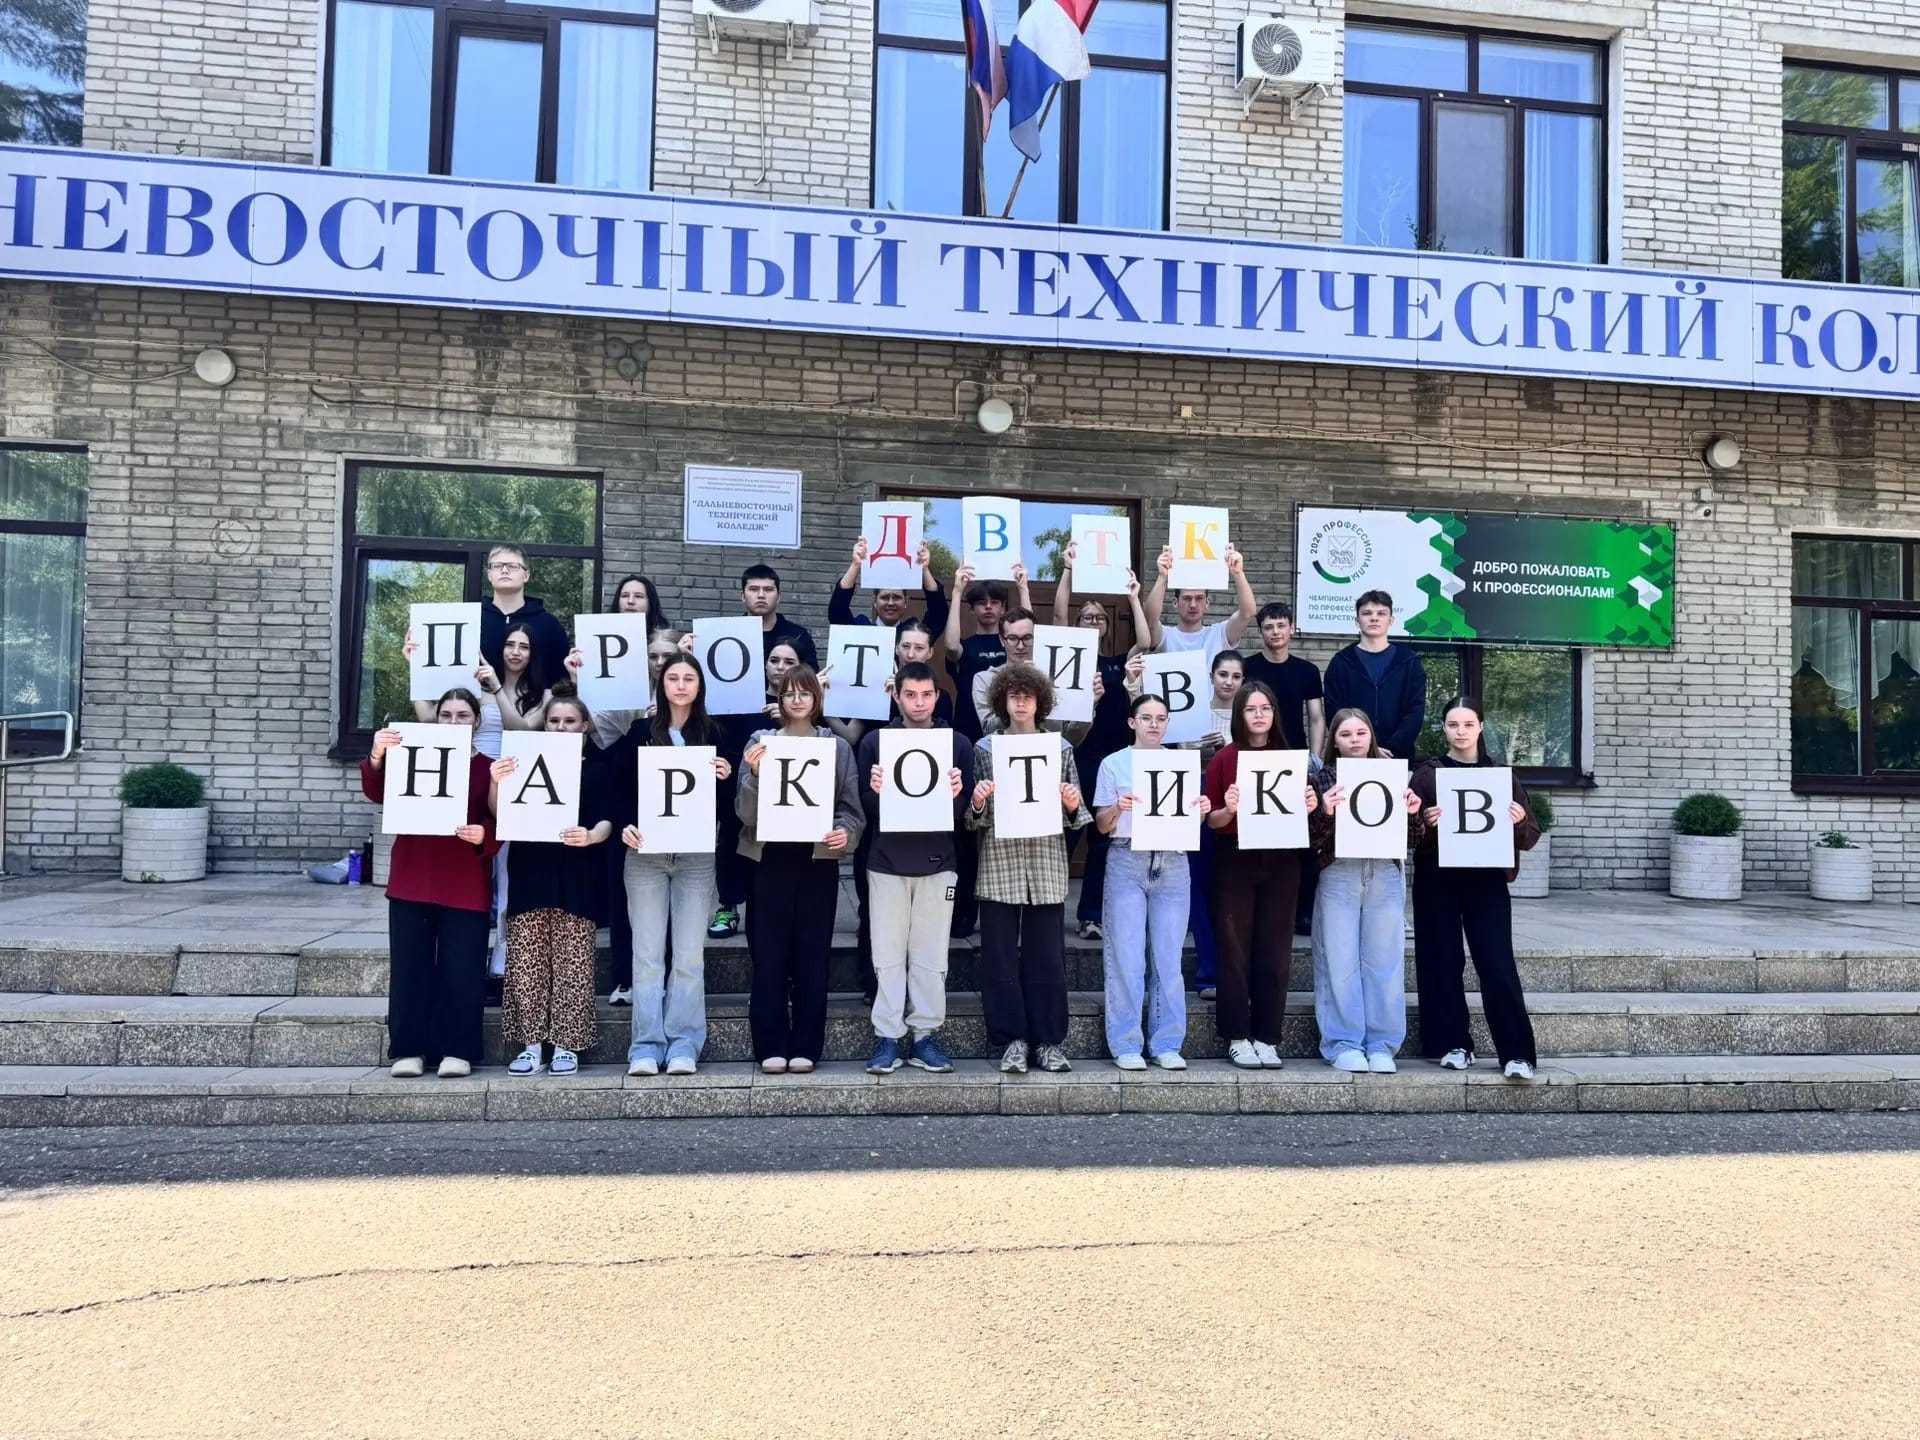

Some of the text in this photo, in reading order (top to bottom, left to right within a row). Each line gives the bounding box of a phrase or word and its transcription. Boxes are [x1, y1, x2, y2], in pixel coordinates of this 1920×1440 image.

[0, 173, 906, 308] НЕВОСТОЧНЫЙ
[940, 243, 1723, 362] ТЕХНИЧЕСКИЙ
[708, 511, 778, 521] ТЕХНИЧЕСКИЙ
[1310, 519, 1373, 582] 2026 ПРОФЕССИОНАЛЫ
[1472, 560, 1611, 579] ДОБРО ПОЖАЛОВАТЬ
[1308, 594, 1353, 602] ЧЕМПИОНАТ
[1472, 581, 1615, 599] К ПРОФЕССИОНАЛАМ!
